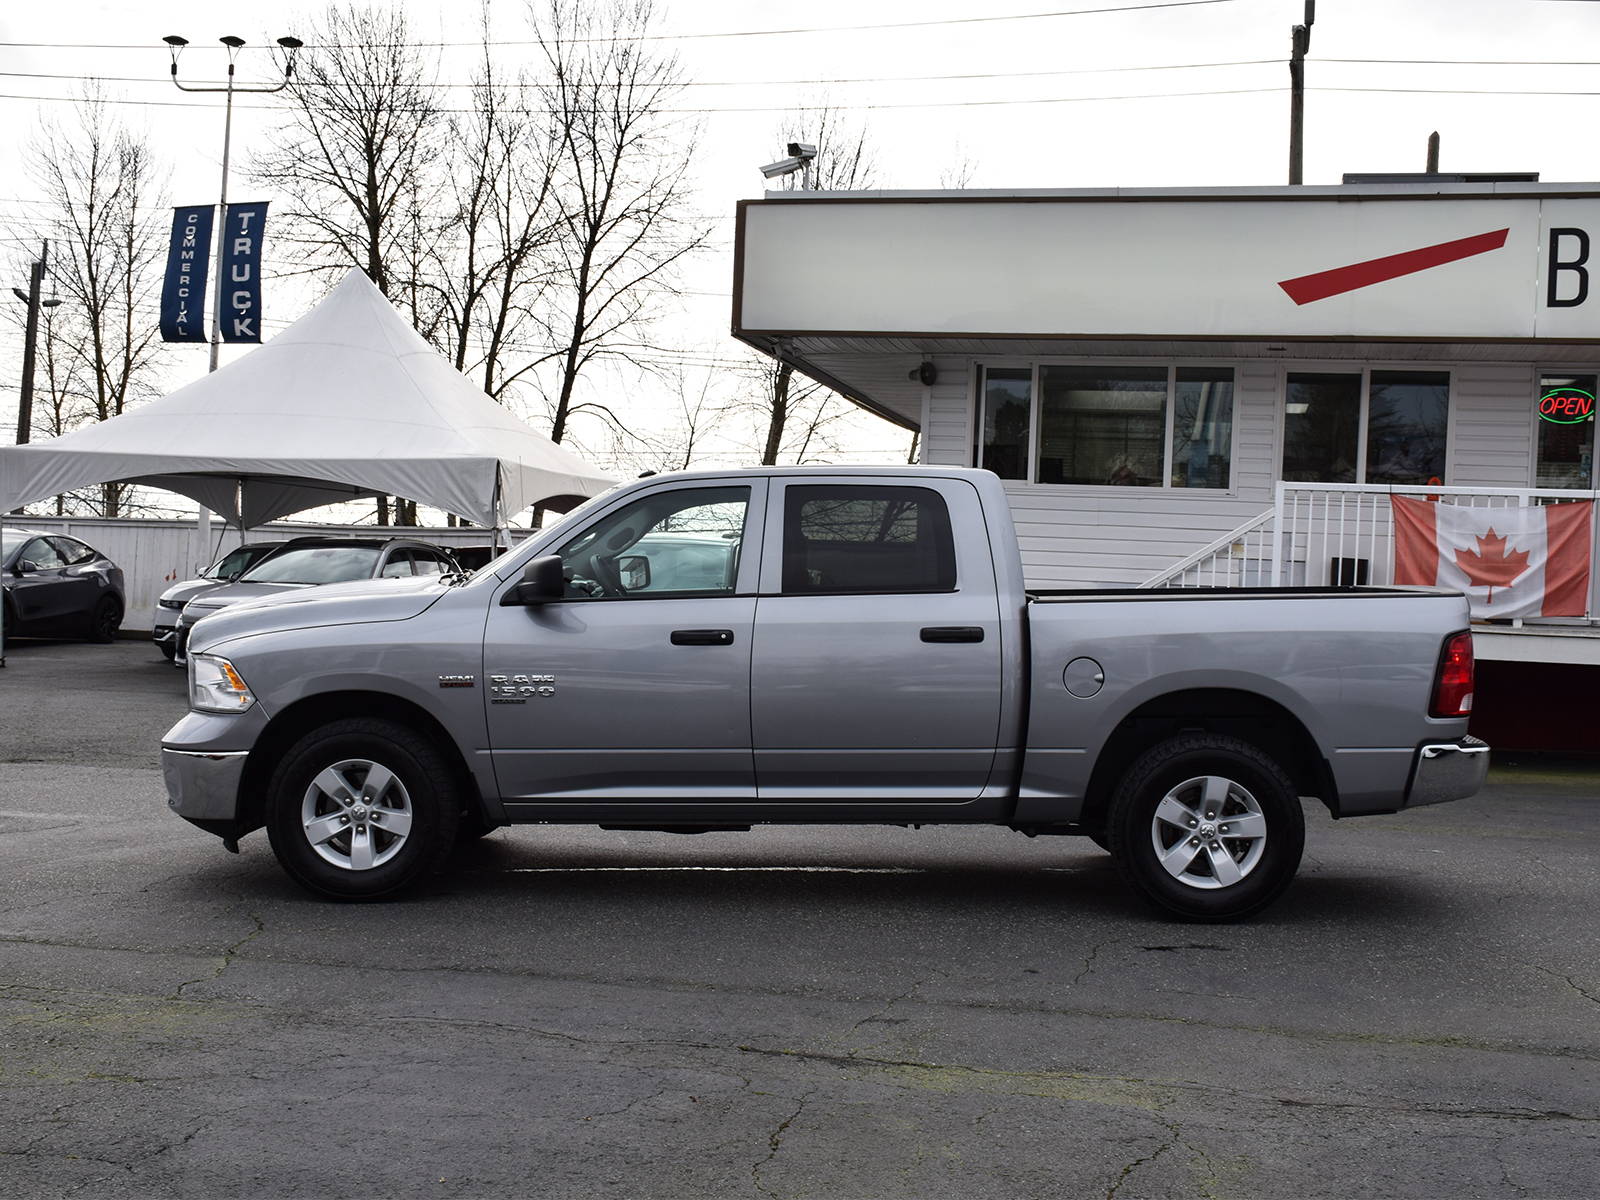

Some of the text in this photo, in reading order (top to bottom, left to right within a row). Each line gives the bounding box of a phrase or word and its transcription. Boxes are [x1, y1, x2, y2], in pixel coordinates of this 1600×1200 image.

[176, 214, 198, 336] COMMERCIAL
[231, 212, 256, 336] TRUCK
[1546, 227, 1590, 308] B
[1540, 397, 1591, 415] OPEN
[490, 674, 555, 686] RAM
[491, 686, 555, 697] 1500
